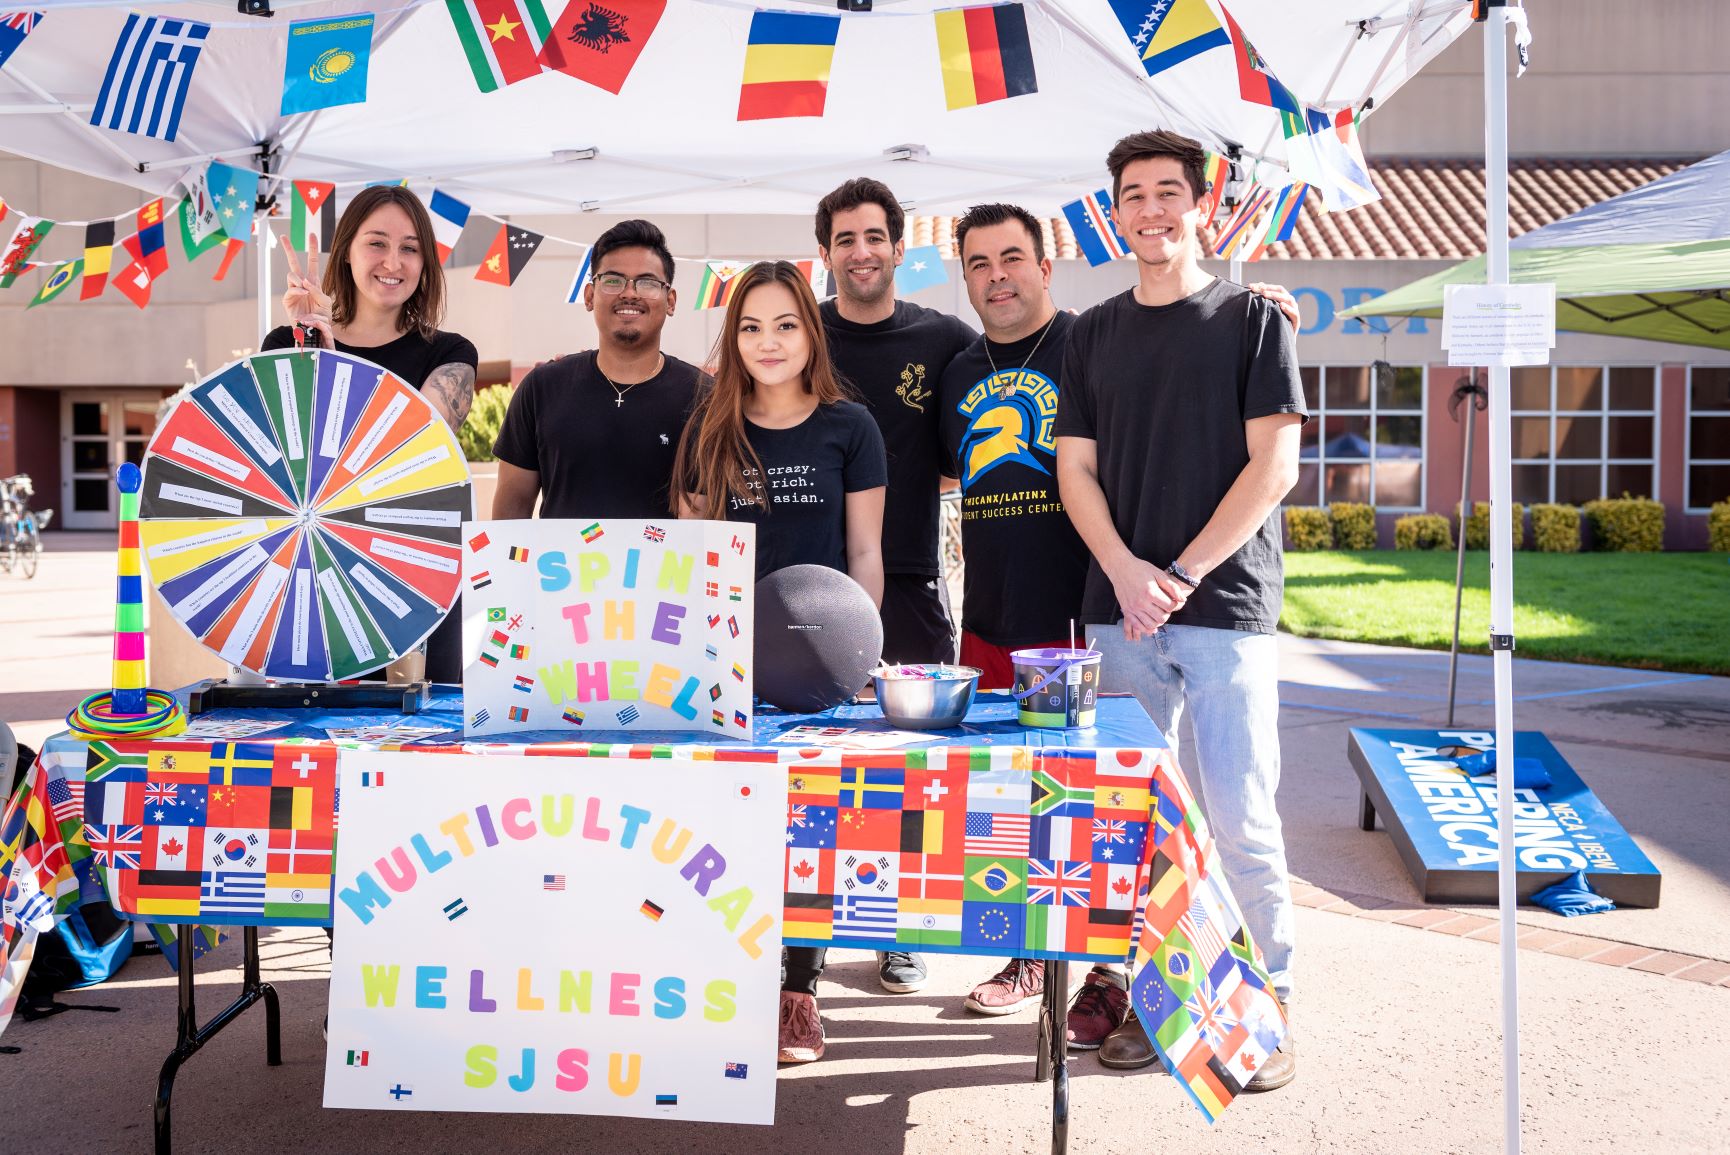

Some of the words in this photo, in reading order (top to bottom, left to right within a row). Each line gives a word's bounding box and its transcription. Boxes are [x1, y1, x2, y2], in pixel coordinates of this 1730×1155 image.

[743, 467, 759, 476] ot
[767, 465, 816, 475] crazy.
[746, 481, 762, 490] ot
[772, 477, 815, 489] rich.
[773, 492, 825, 504] asian.
[982, 506, 1023, 519] SUCCESS
[537, 548, 695, 595] SPIN
[562, 600, 687, 646] THE
[537, 659, 701, 721] WHEEL
[1390, 741, 1500, 866] AMERICA
[1548, 803, 1588, 832] NECA
[1577, 842, 1620, 871] IBEW
[338, 794, 775, 960] MULTICULTURAL
[361, 964, 737, 1022] WELLNESS
[464, 1044, 642, 1097] SJSU
